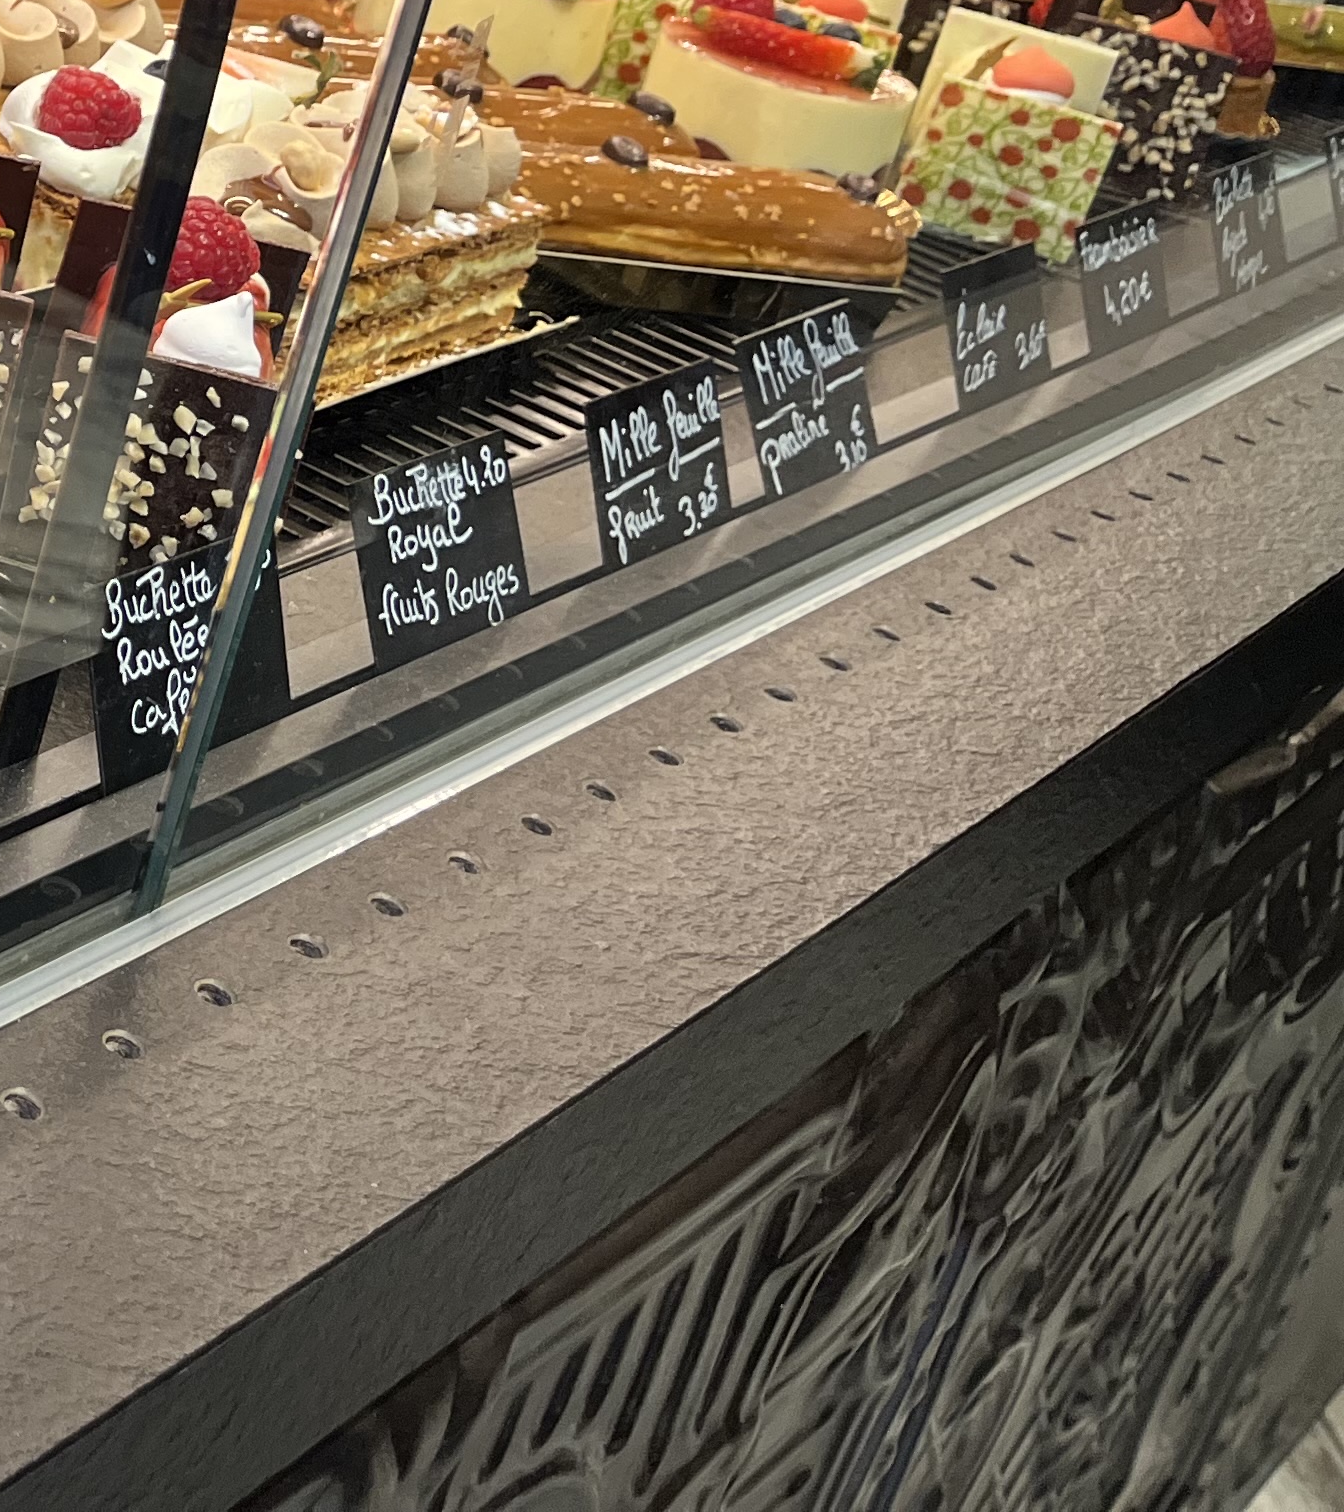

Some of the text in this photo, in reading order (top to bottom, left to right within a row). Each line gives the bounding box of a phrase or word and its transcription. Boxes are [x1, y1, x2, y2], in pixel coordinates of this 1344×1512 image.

[753, 334, 812, 405] Mille
[599, 375, 721, 483] Mille feuille
[367, 461, 467, 525] Buchette
[608, 485, 665, 565] fruit
[387, 501, 473, 572] Royal
[101, 560, 218, 639] Buchette
[378, 563, 520, 636] fruits Rouges
